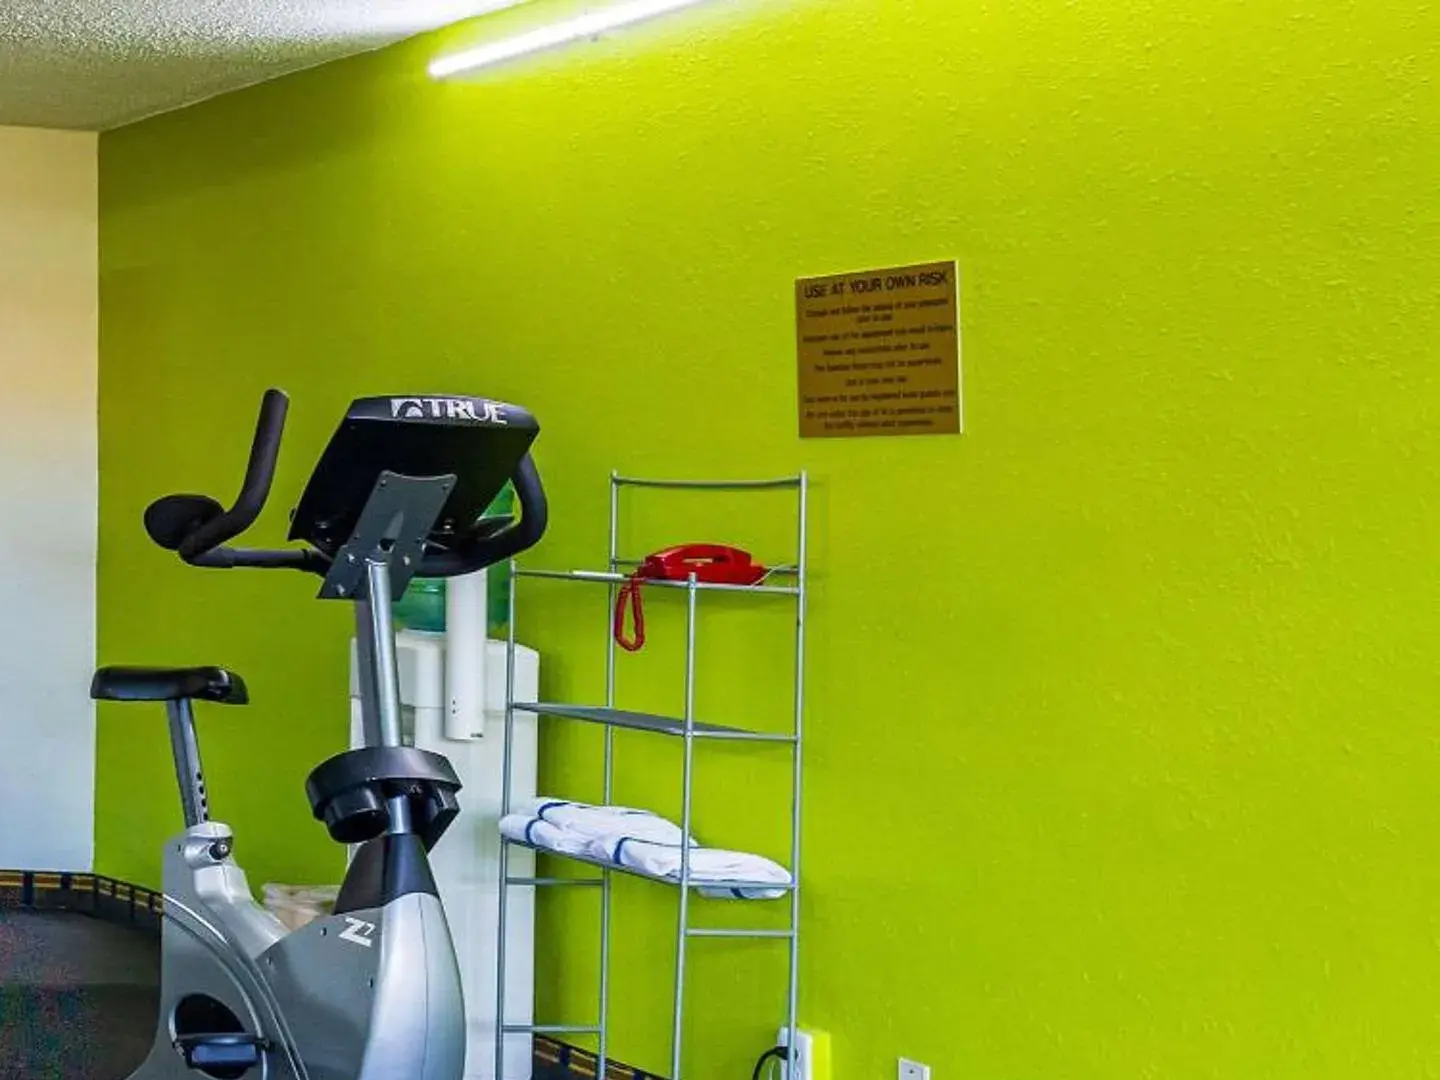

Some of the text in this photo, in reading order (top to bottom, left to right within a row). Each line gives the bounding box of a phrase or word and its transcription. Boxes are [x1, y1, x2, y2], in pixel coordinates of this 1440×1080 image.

[804, 270, 947, 299] USE AT YOUR OWN RISK
[422, 398, 508, 424] TRUE
